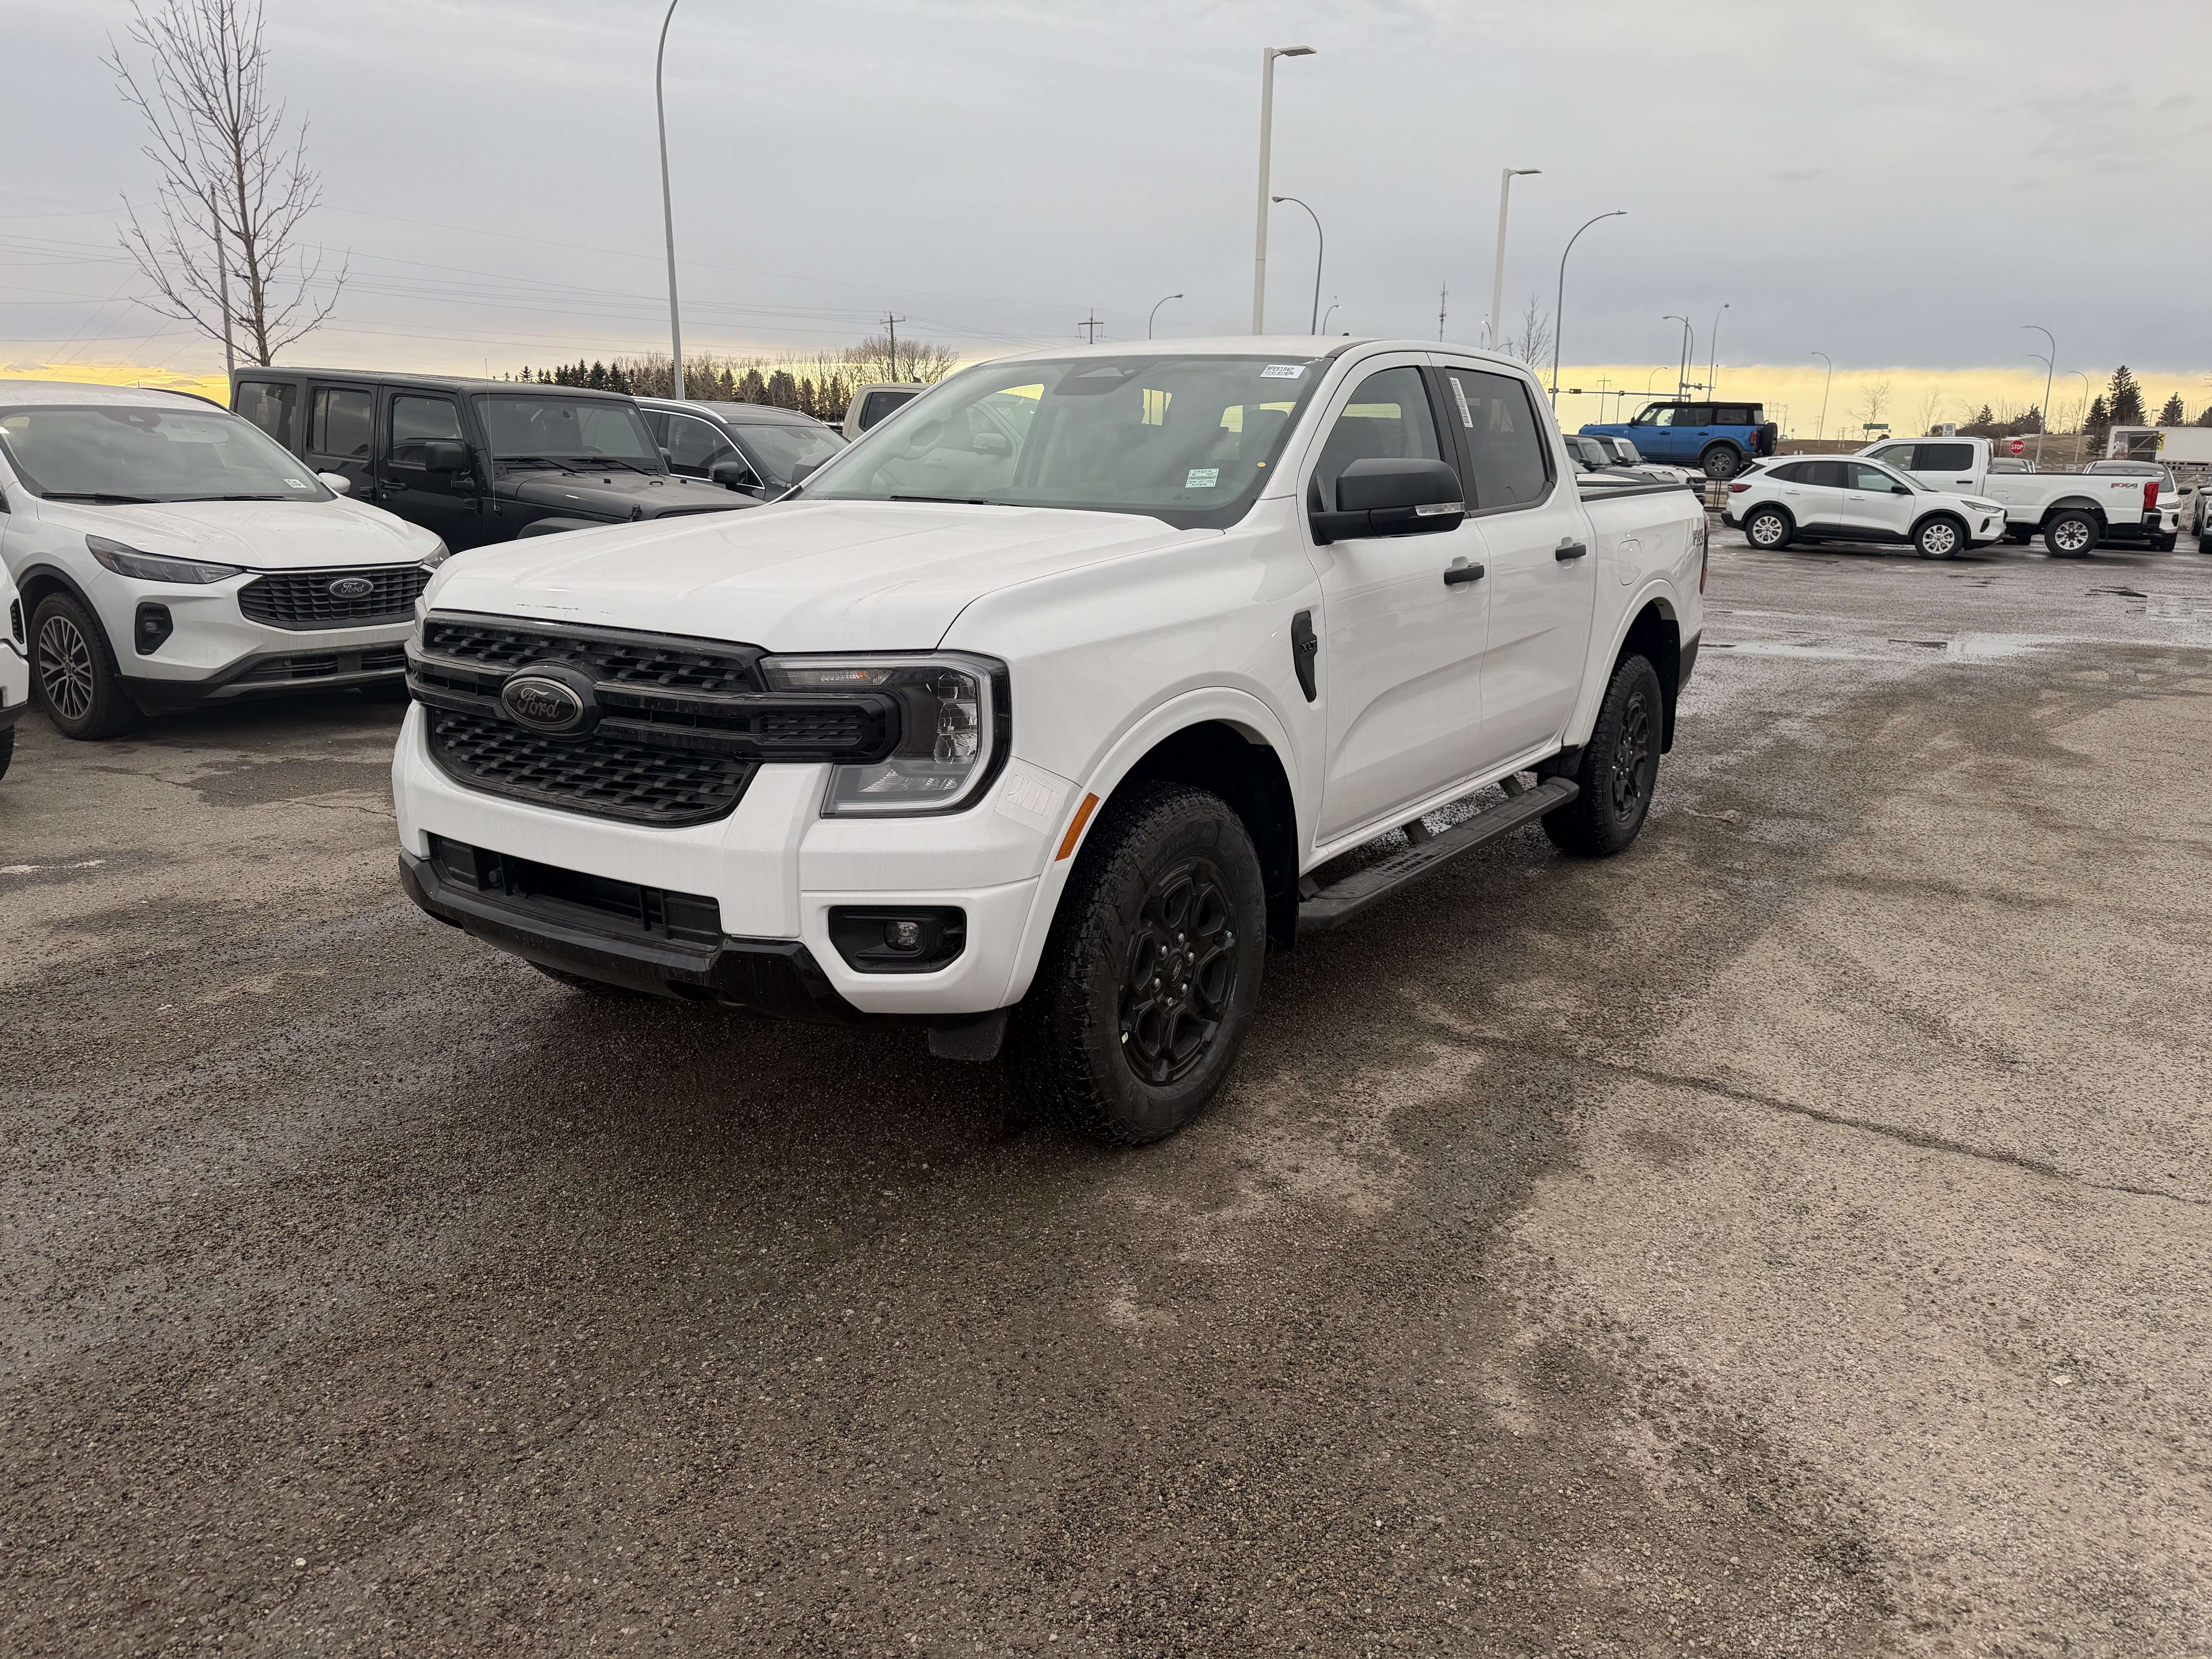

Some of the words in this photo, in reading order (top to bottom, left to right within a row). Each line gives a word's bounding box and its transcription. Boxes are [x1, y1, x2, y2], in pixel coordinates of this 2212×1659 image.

[1692, 528, 1703, 546] FX4
[341, 582, 364, 593] Ford
[1300, 640, 1317, 653] XLT
[517, 687, 560, 719] Ford
